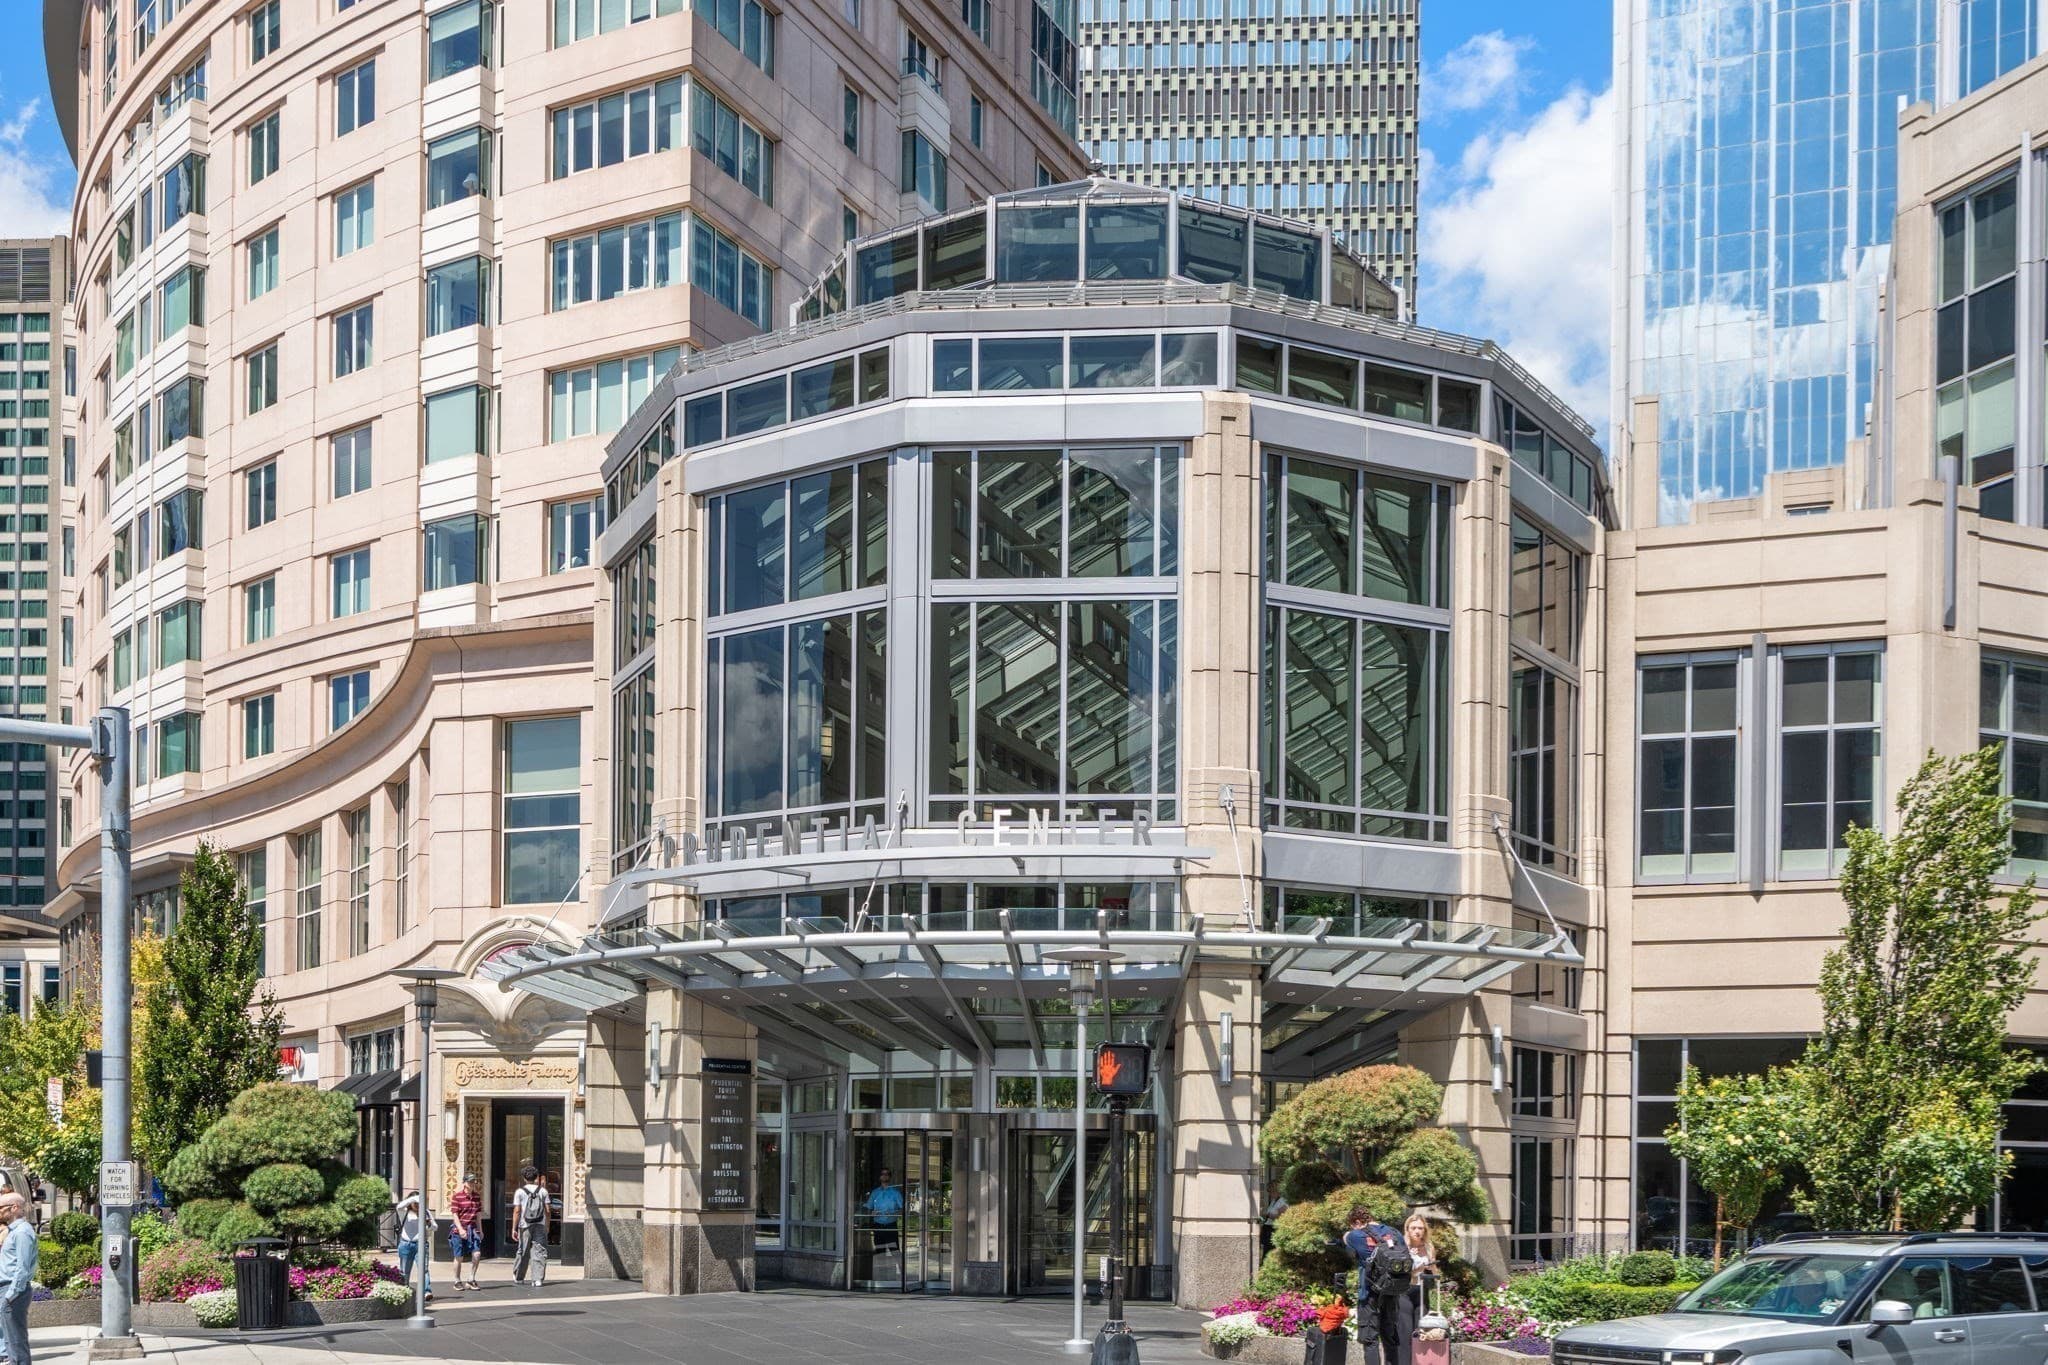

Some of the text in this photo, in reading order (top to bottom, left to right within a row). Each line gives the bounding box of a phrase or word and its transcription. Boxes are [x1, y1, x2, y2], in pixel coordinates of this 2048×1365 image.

[663, 808, 1153, 868] PRUDENTIAL CENTER
[455, 1060, 579, 1087] Cheesecake Factory
[710, 1143, 743, 1151] HUNTINGTON
